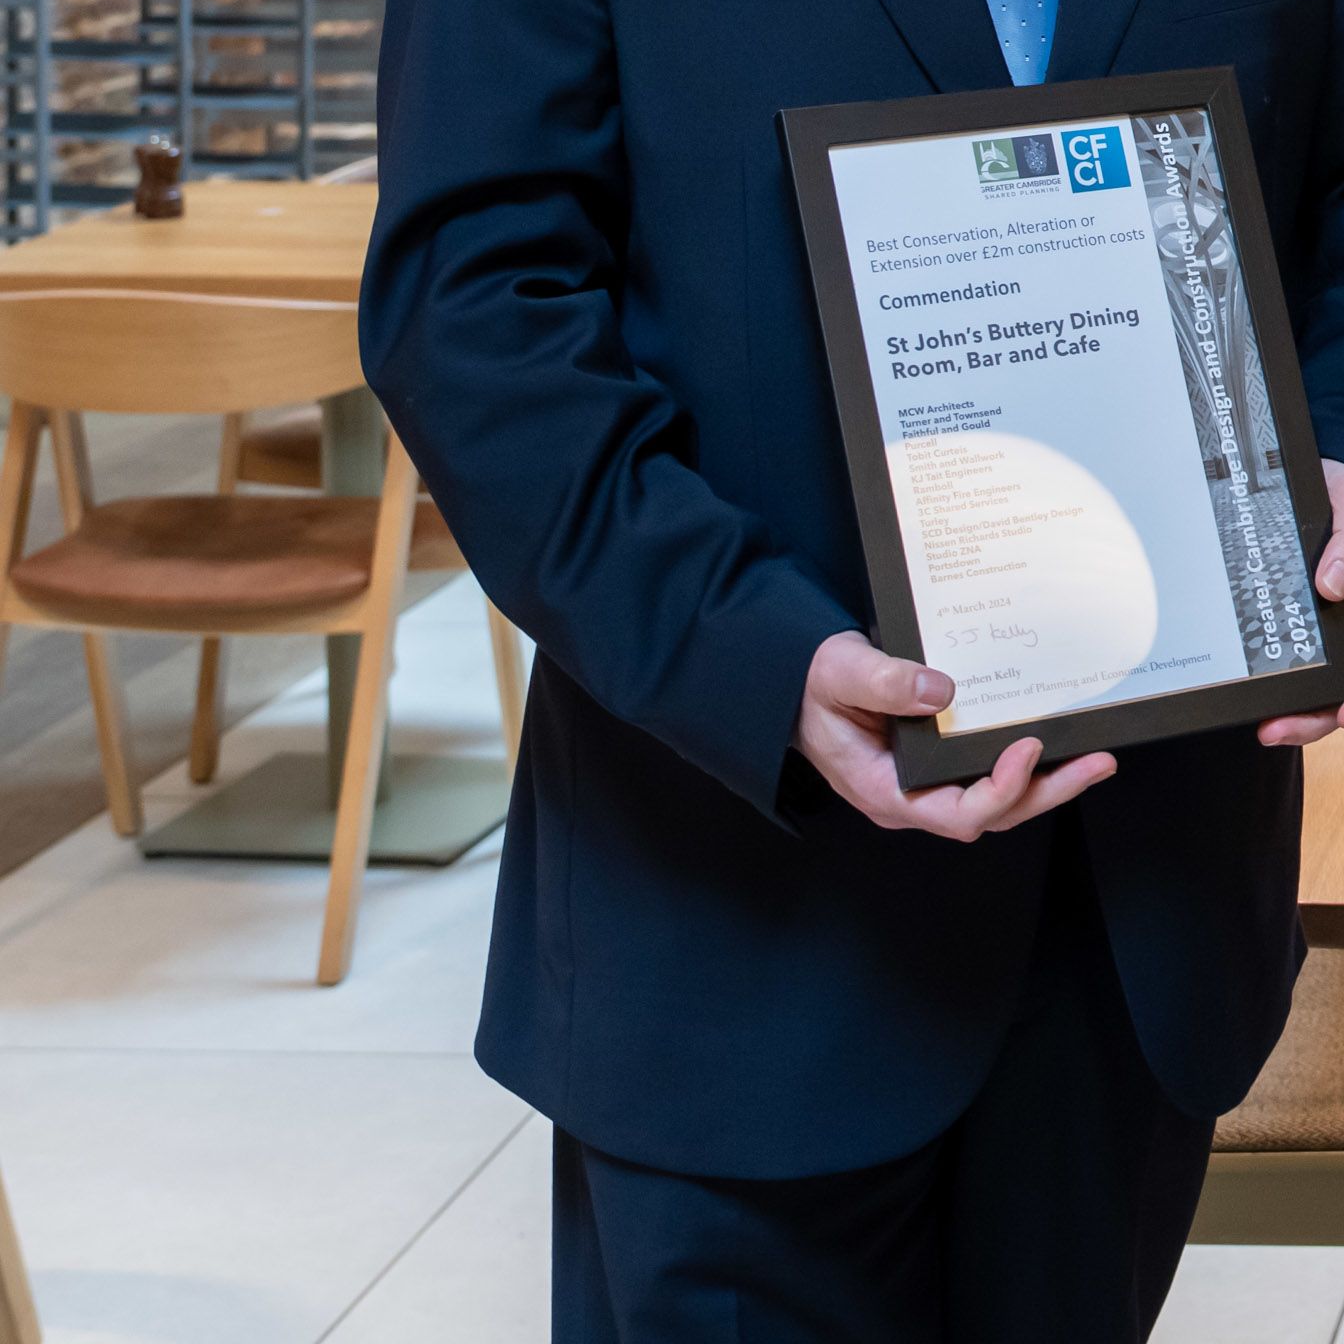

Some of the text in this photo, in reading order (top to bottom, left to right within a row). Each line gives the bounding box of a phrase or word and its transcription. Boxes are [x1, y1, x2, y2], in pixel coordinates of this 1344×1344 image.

[1069, 133, 1107, 160] CF
[866, 215, 1096, 253] Best Conservation, Alteration or
[870, 228, 1146, 274] Extension over £2m construction costs
[879, 280, 1021, 311] Commendation
[886, 336, 910, 355] St
[987, 319, 1065, 342] Buttery
[1069, 307, 1140, 330] Dining
[891, 334, 1101, 380] Room, Bar and Cafe
[1154, 122, 1284, 661] Greater Cambridge Design and Construction Awards
[898, 401, 975, 418] MCW Architects
[899, 405, 1002, 429] Turner and Townsend
[902, 418, 991, 440] Faithful and Gould
[1283, 600, 1311, 655] 2024
[1148, 653, 1211, 671] Development
[957, 674, 992, 689] tephen
